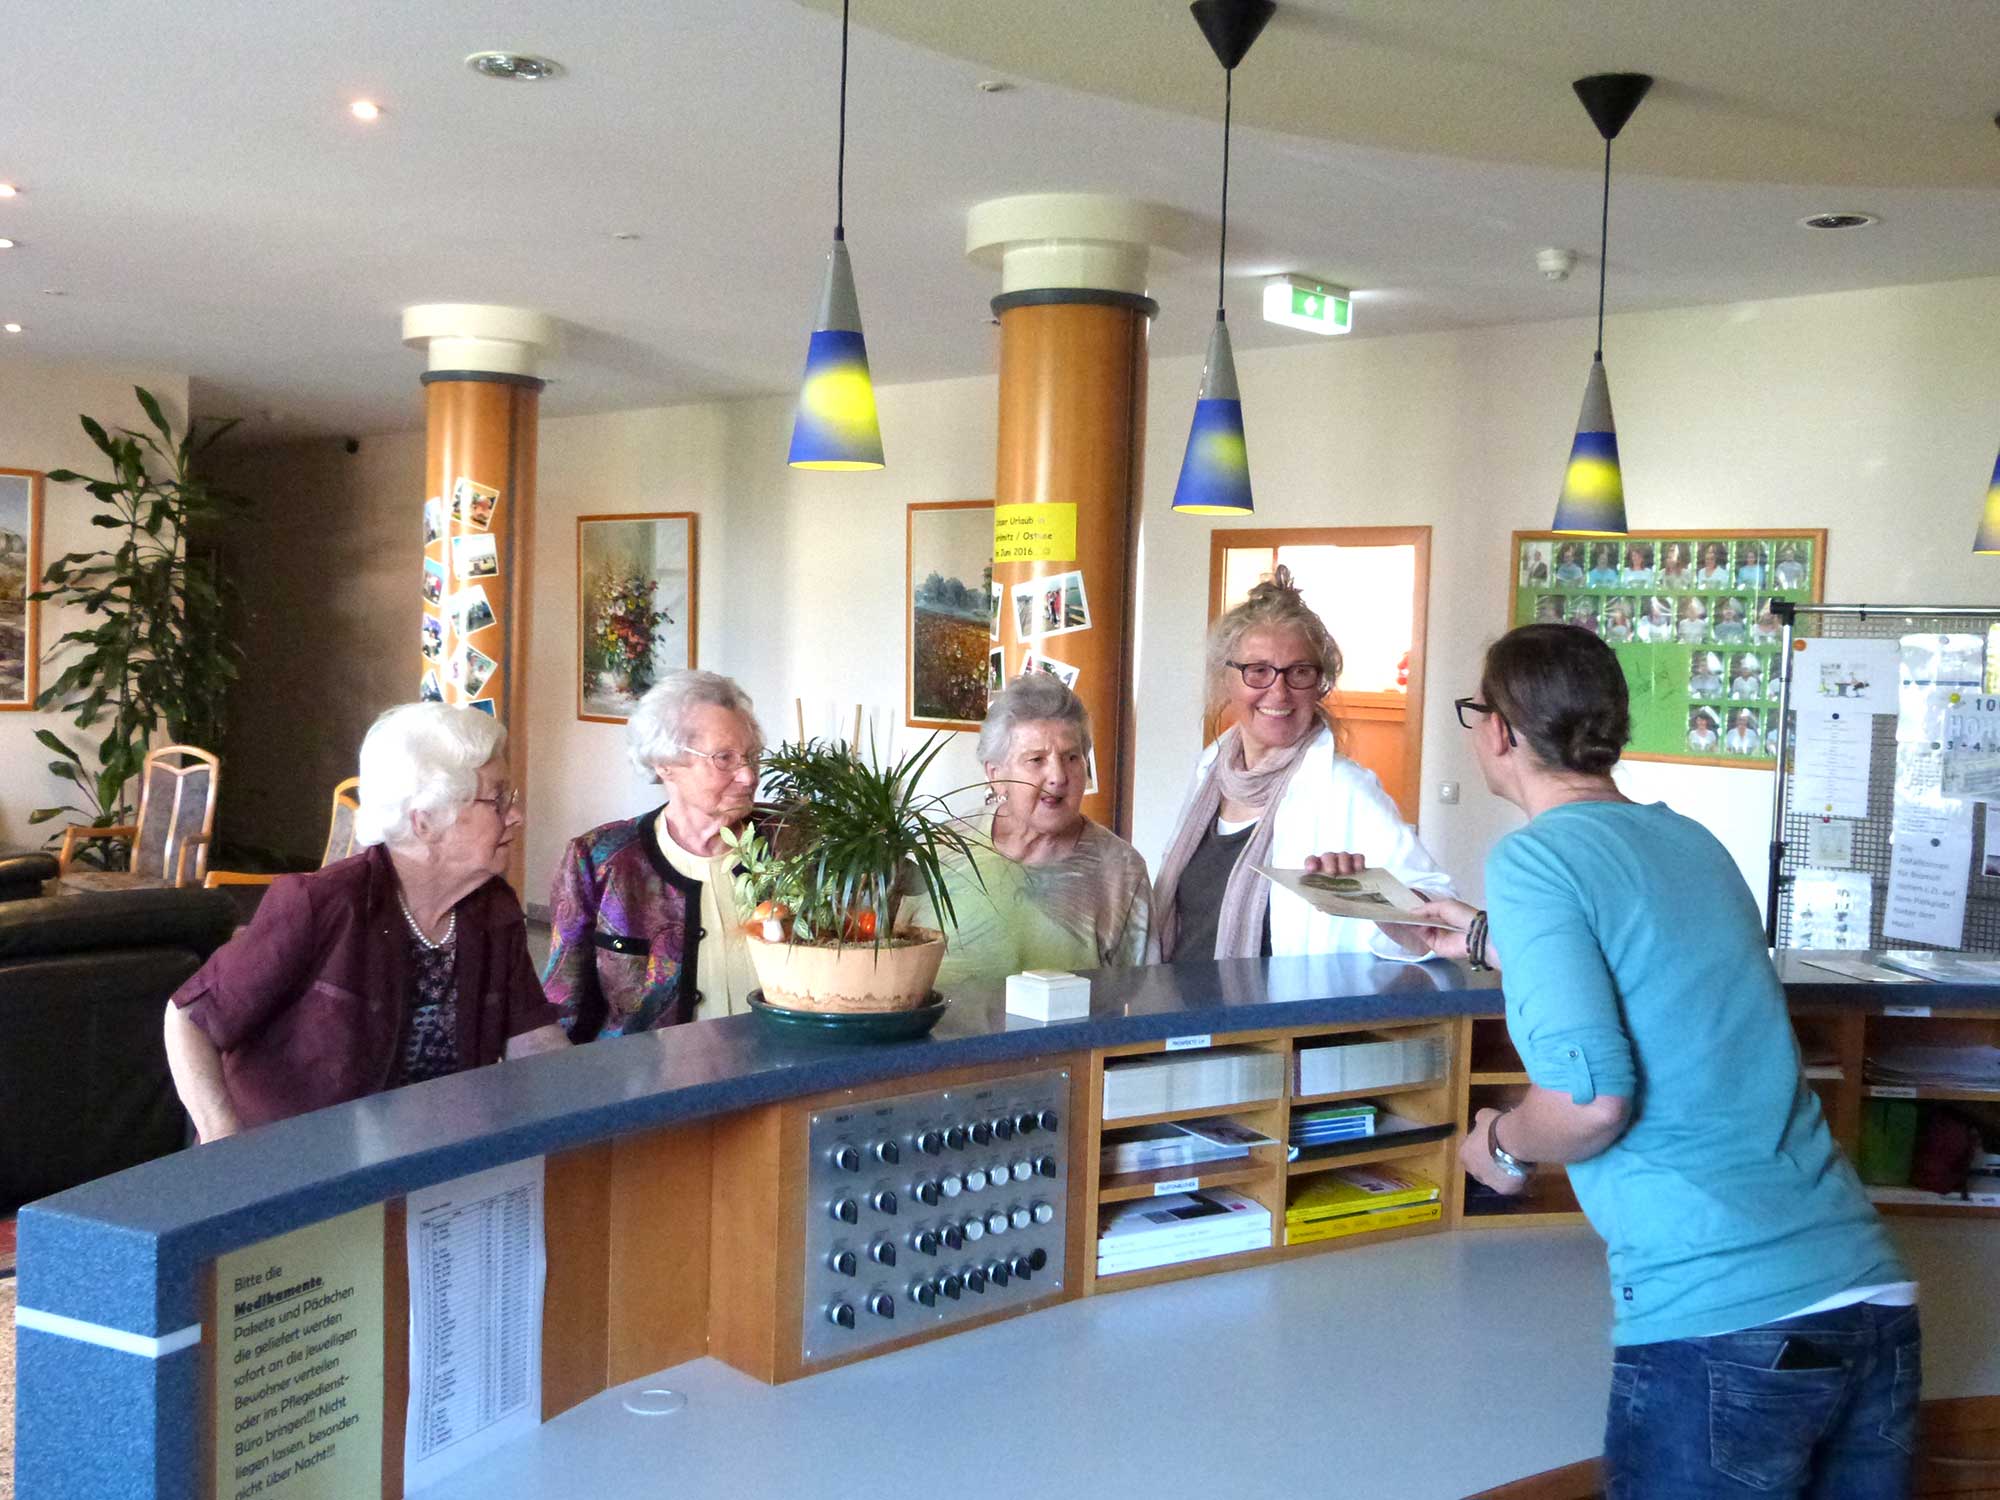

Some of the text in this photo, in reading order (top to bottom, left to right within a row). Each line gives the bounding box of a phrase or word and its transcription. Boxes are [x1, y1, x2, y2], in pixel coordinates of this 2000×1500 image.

[1010, 516, 1034, 525] Urlaub
[1014, 547, 1033, 556] 2016
[234, 1265, 282, 1292] Bitte die
[234, 1286, 354, 1340] Pakete und Päckchen
[234, 1312, 342, 1365] die geliefert werden
[234, 1328, 358, 1387] sofort an die jeweiligen
[234, 1357, 340, 1411] Bewohner verteilen
[234, 1374, 350, 1434] oder ins Pflegedienst-
[235, 1396, 347, 1457] Büro bringen!!! Nicht
[235, 1456, 269, 1480] liegen
[308, 1413, 360, 1444] besonders
[235, 1443, 336, 1500] nicht über Nacht!!!
